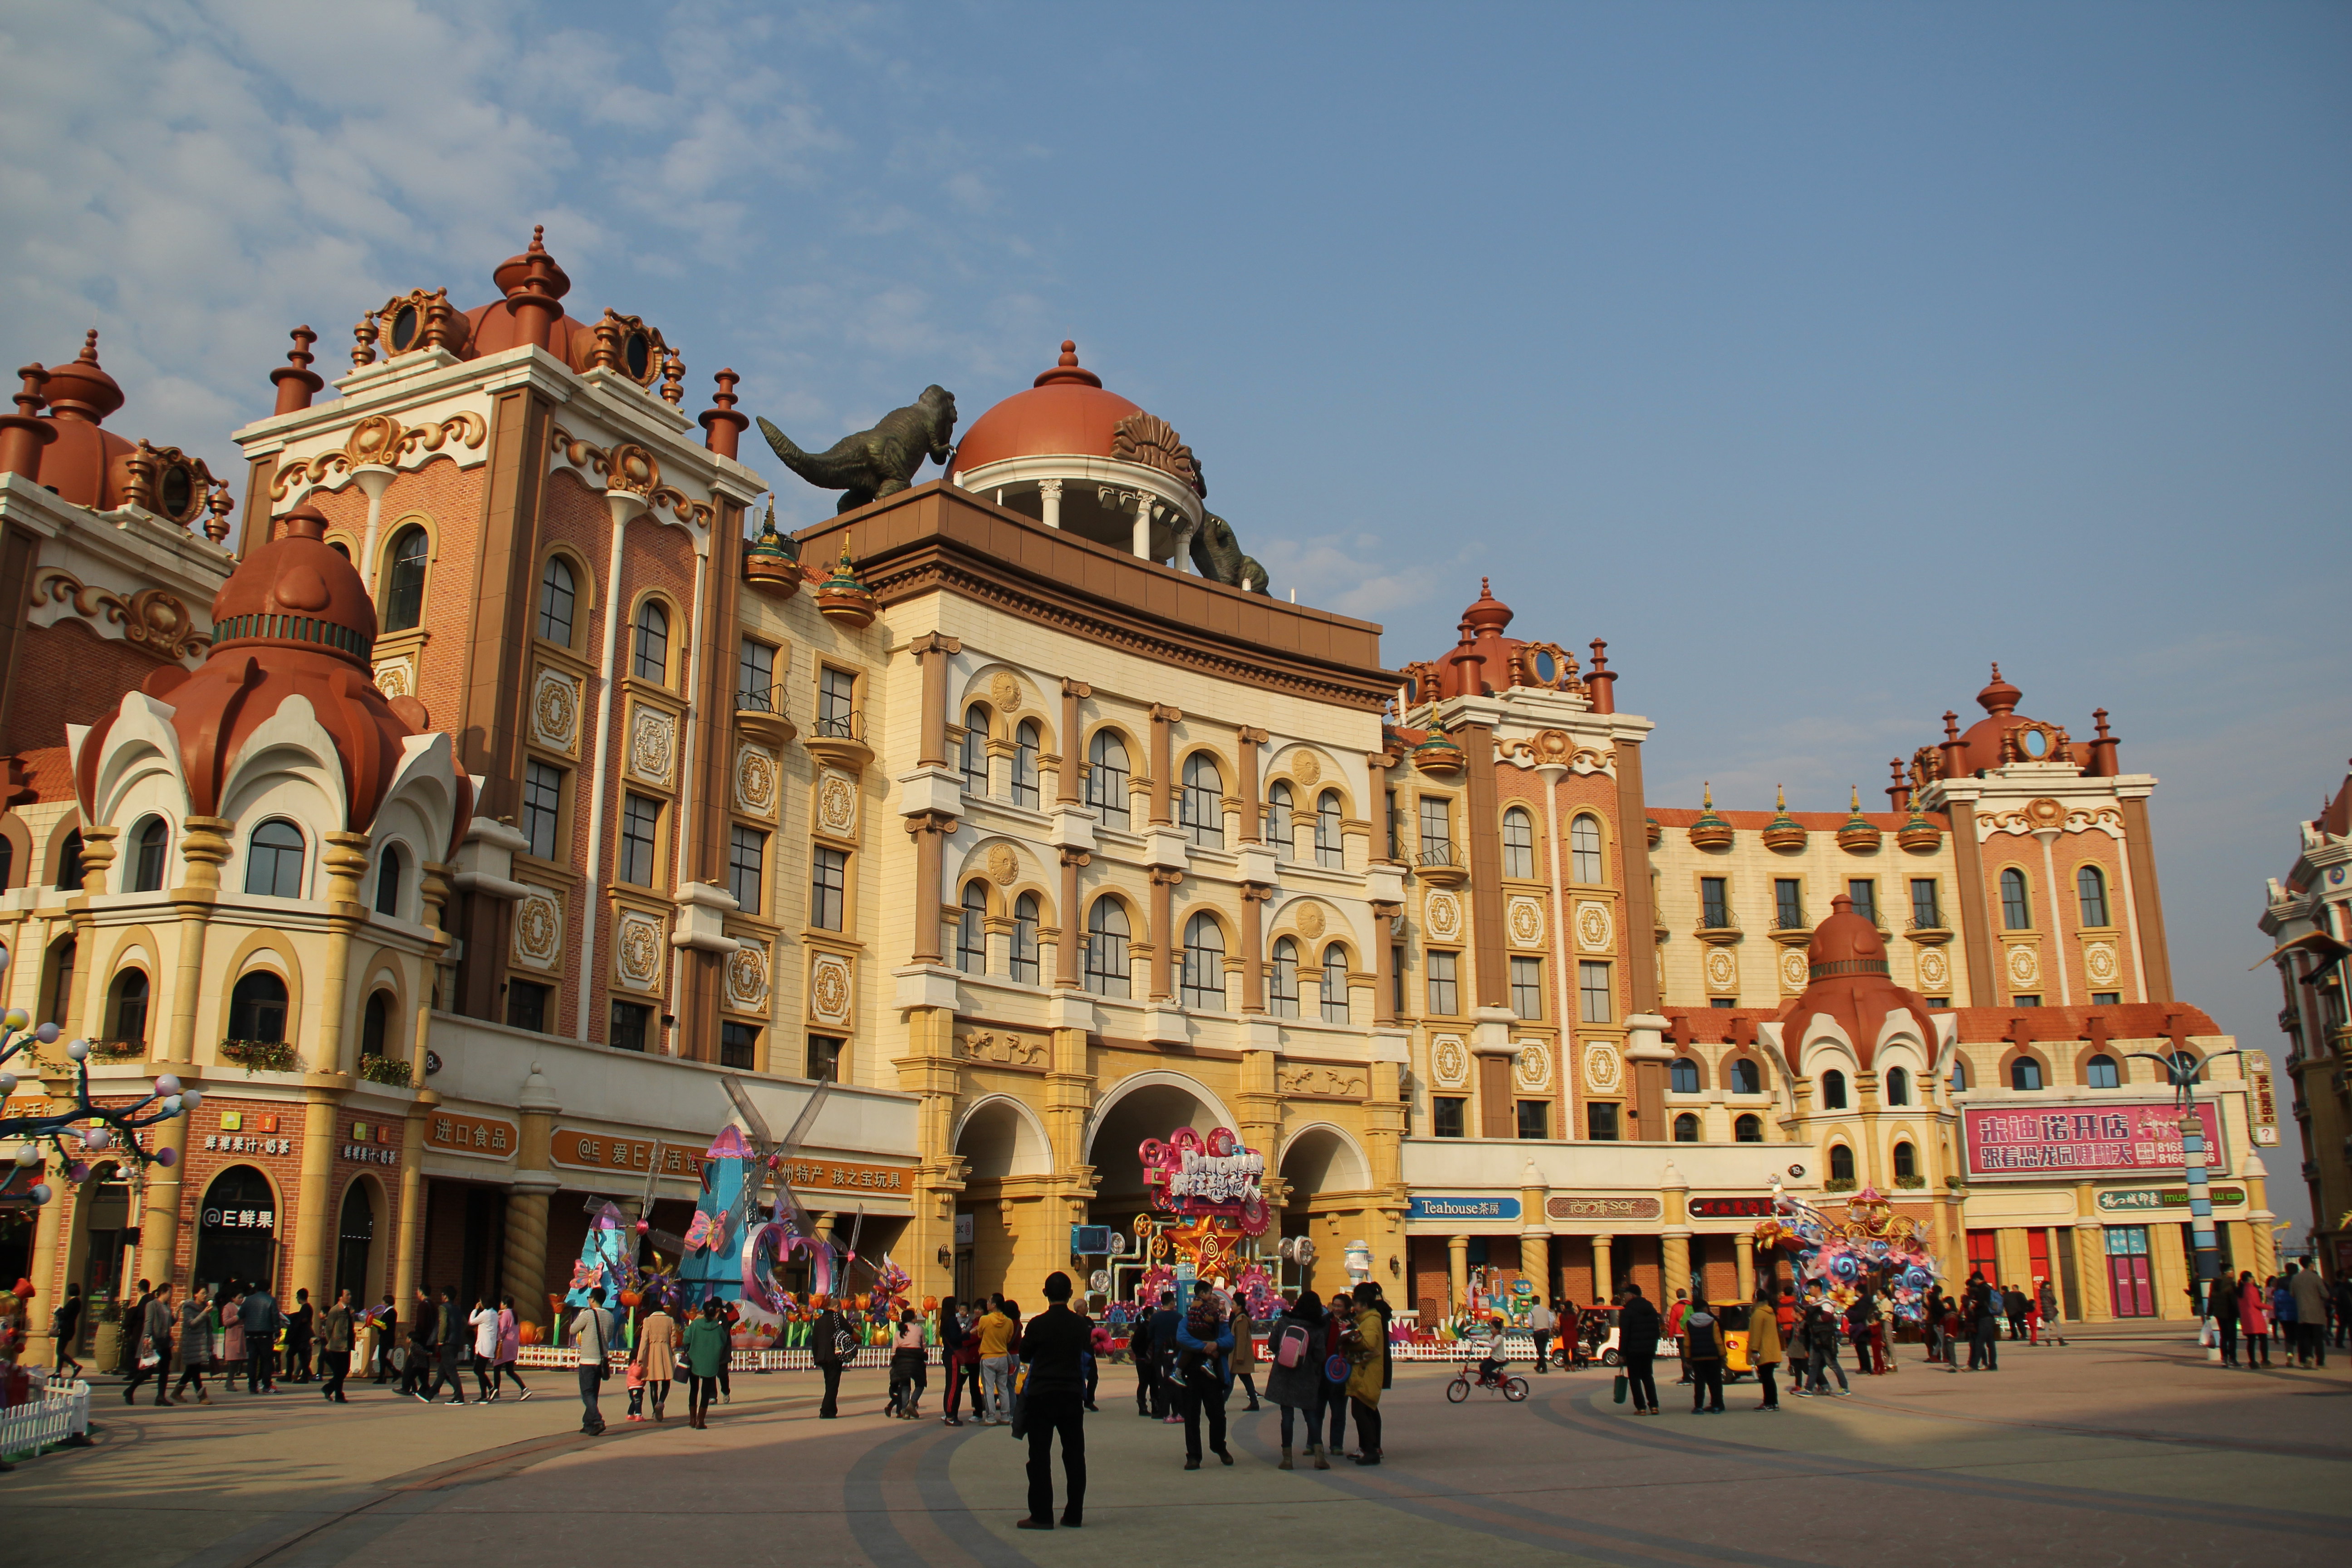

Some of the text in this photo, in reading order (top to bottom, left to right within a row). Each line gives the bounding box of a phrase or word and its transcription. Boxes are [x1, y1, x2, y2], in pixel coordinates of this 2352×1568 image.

[435, 1118, 507, 1149] 进口食品
[1979, 1113, 2130, 1143] 来迪诺开店
[1181, 1150, 1264, 1176] DINOMAN
[1980, 1143, 2134, 1169] 跟着恐龙园赚翻天
[831, 1167, 901, 1189] 孩之宝玩具
